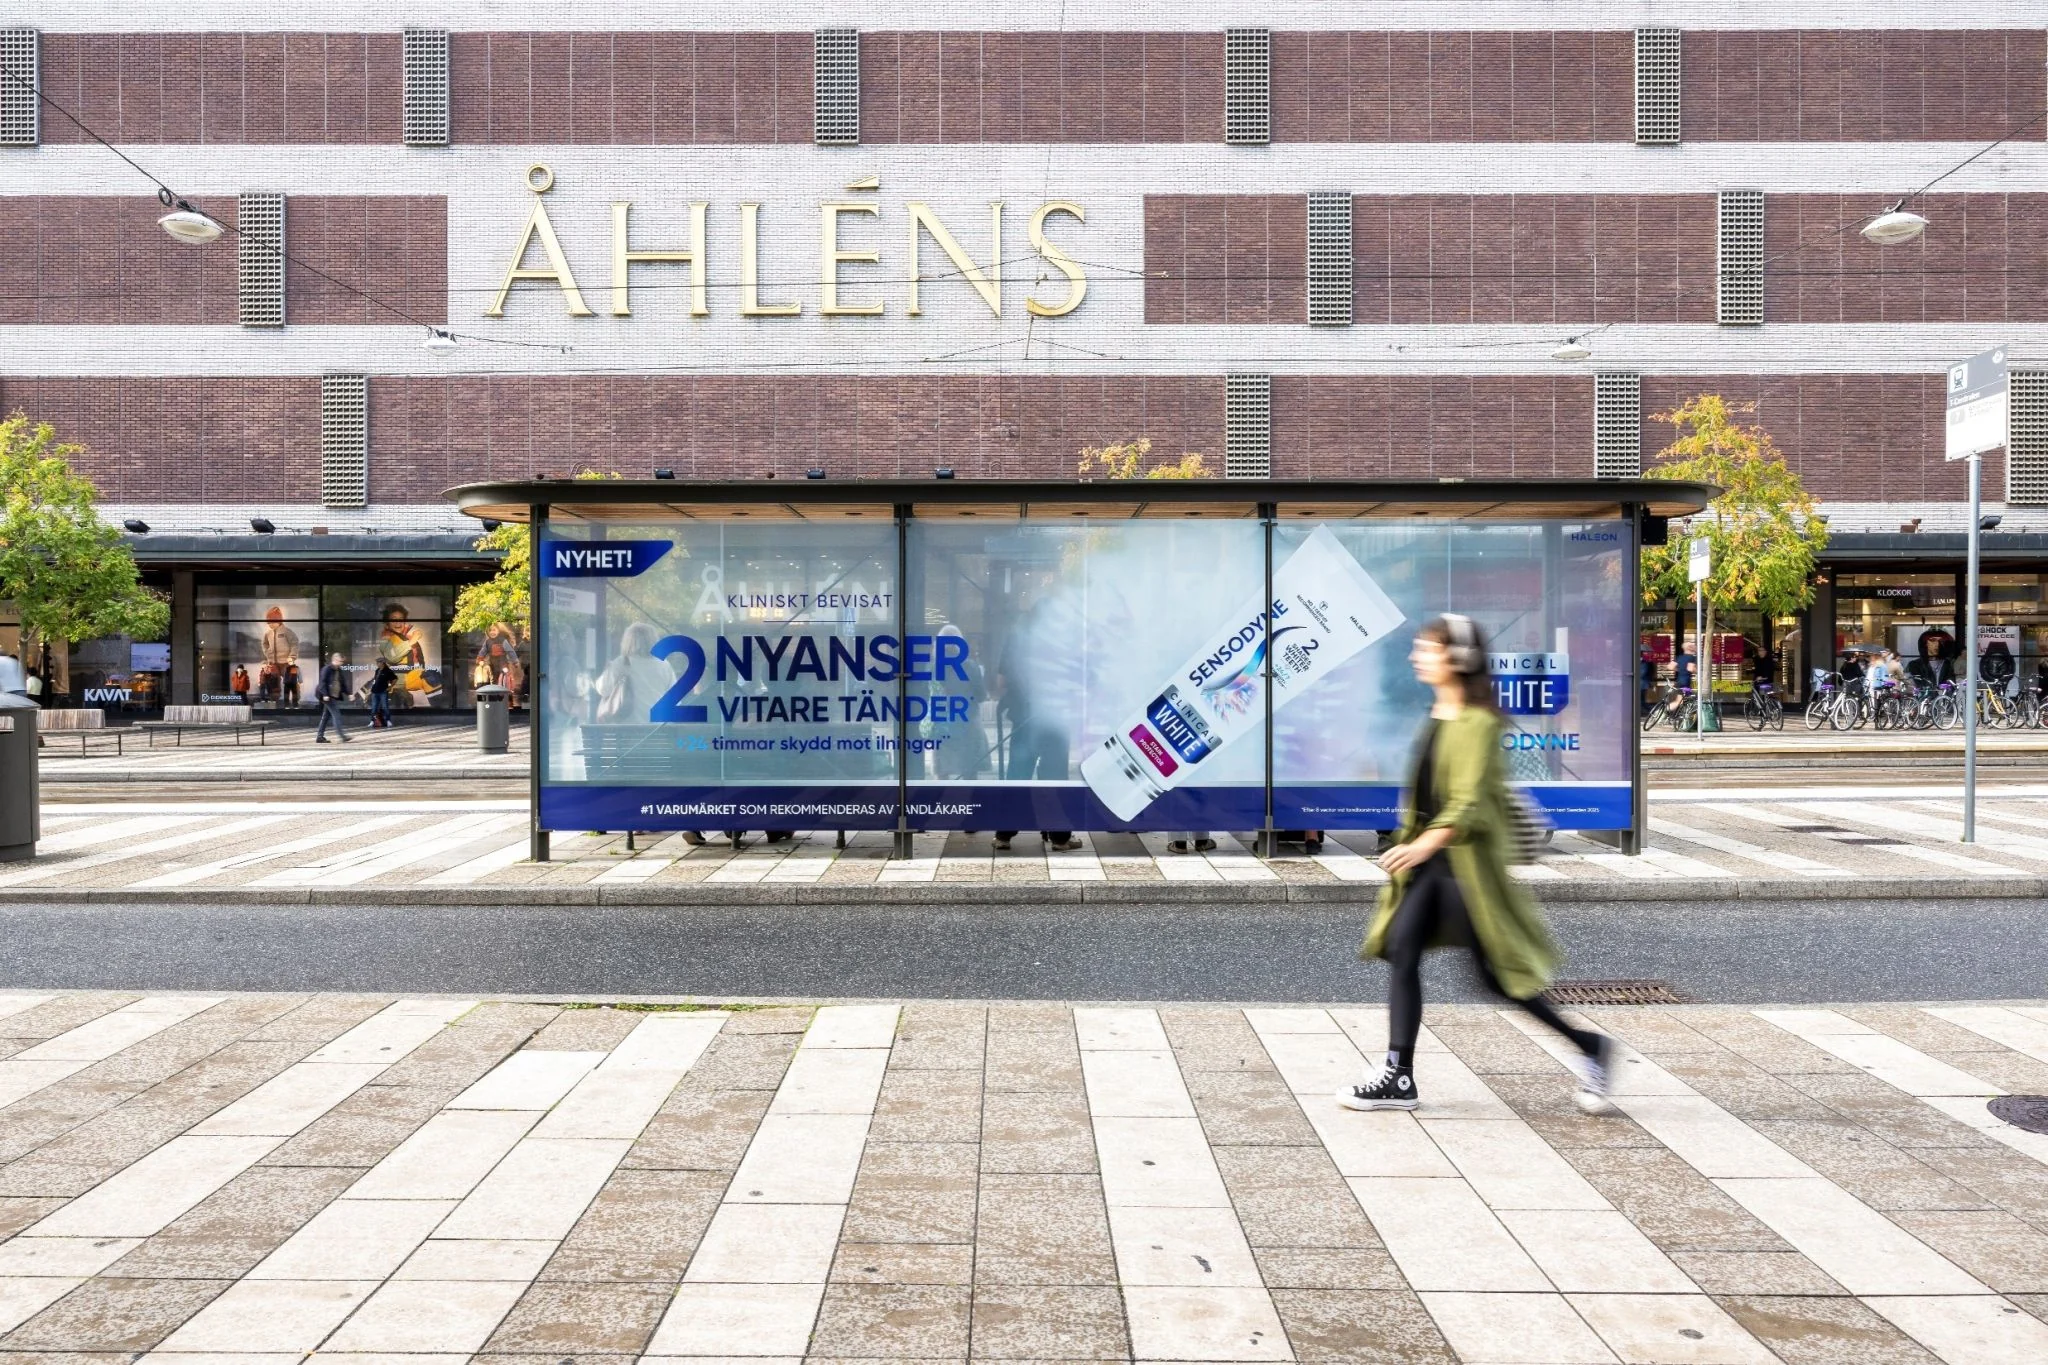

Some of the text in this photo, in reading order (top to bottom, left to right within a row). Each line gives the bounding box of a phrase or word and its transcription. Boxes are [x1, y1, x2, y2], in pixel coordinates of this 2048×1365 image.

[484, 163, 1087, 317] ÅHLÉNS
[1571, 533, 1618, 541] HALEON
[555, 549, 632, 568] NYHET!
[728, 594, 893, 608] KLINISKT BEVISAT
[1349, 615, 1368, 637] HALEON
[1189, 599, 1289, 687] SENSODYNE
[1301, 638, 1319, 656] 2
[716, 635, 970, 682] NYANSER
[1286, 645, 1309, 672] WHITER
[1292, 643, 1312, 666] SHADES
[1490, 658, 1557, 669] INICAL
[340, 664, 369, 672] signed
[650, 635, 708, 722] 2
[84, 689, 132, 701] KAVAT
[1490, 680, 1554, 708] HITE
[717, 696, 829, 722] VITARE
[1170, 692, 1214, 743] CLINICAL
[1155, 704, 1202, 757] WHITE
[712, 736, 775, 750] timmar
[780, 736, 831, 754] skydd
[837, 737, 871, 750] mot
[1139, 739, 1164, 766] PROTECTOR
[1150, 741, 1164, 756] STAIN
[1501, 733, 1580, 751] ODYNE
[640, 802, 981, 814] #1 VARUMÄRKET SOM REKOMMENDERAS AV ANDLÄKARE
